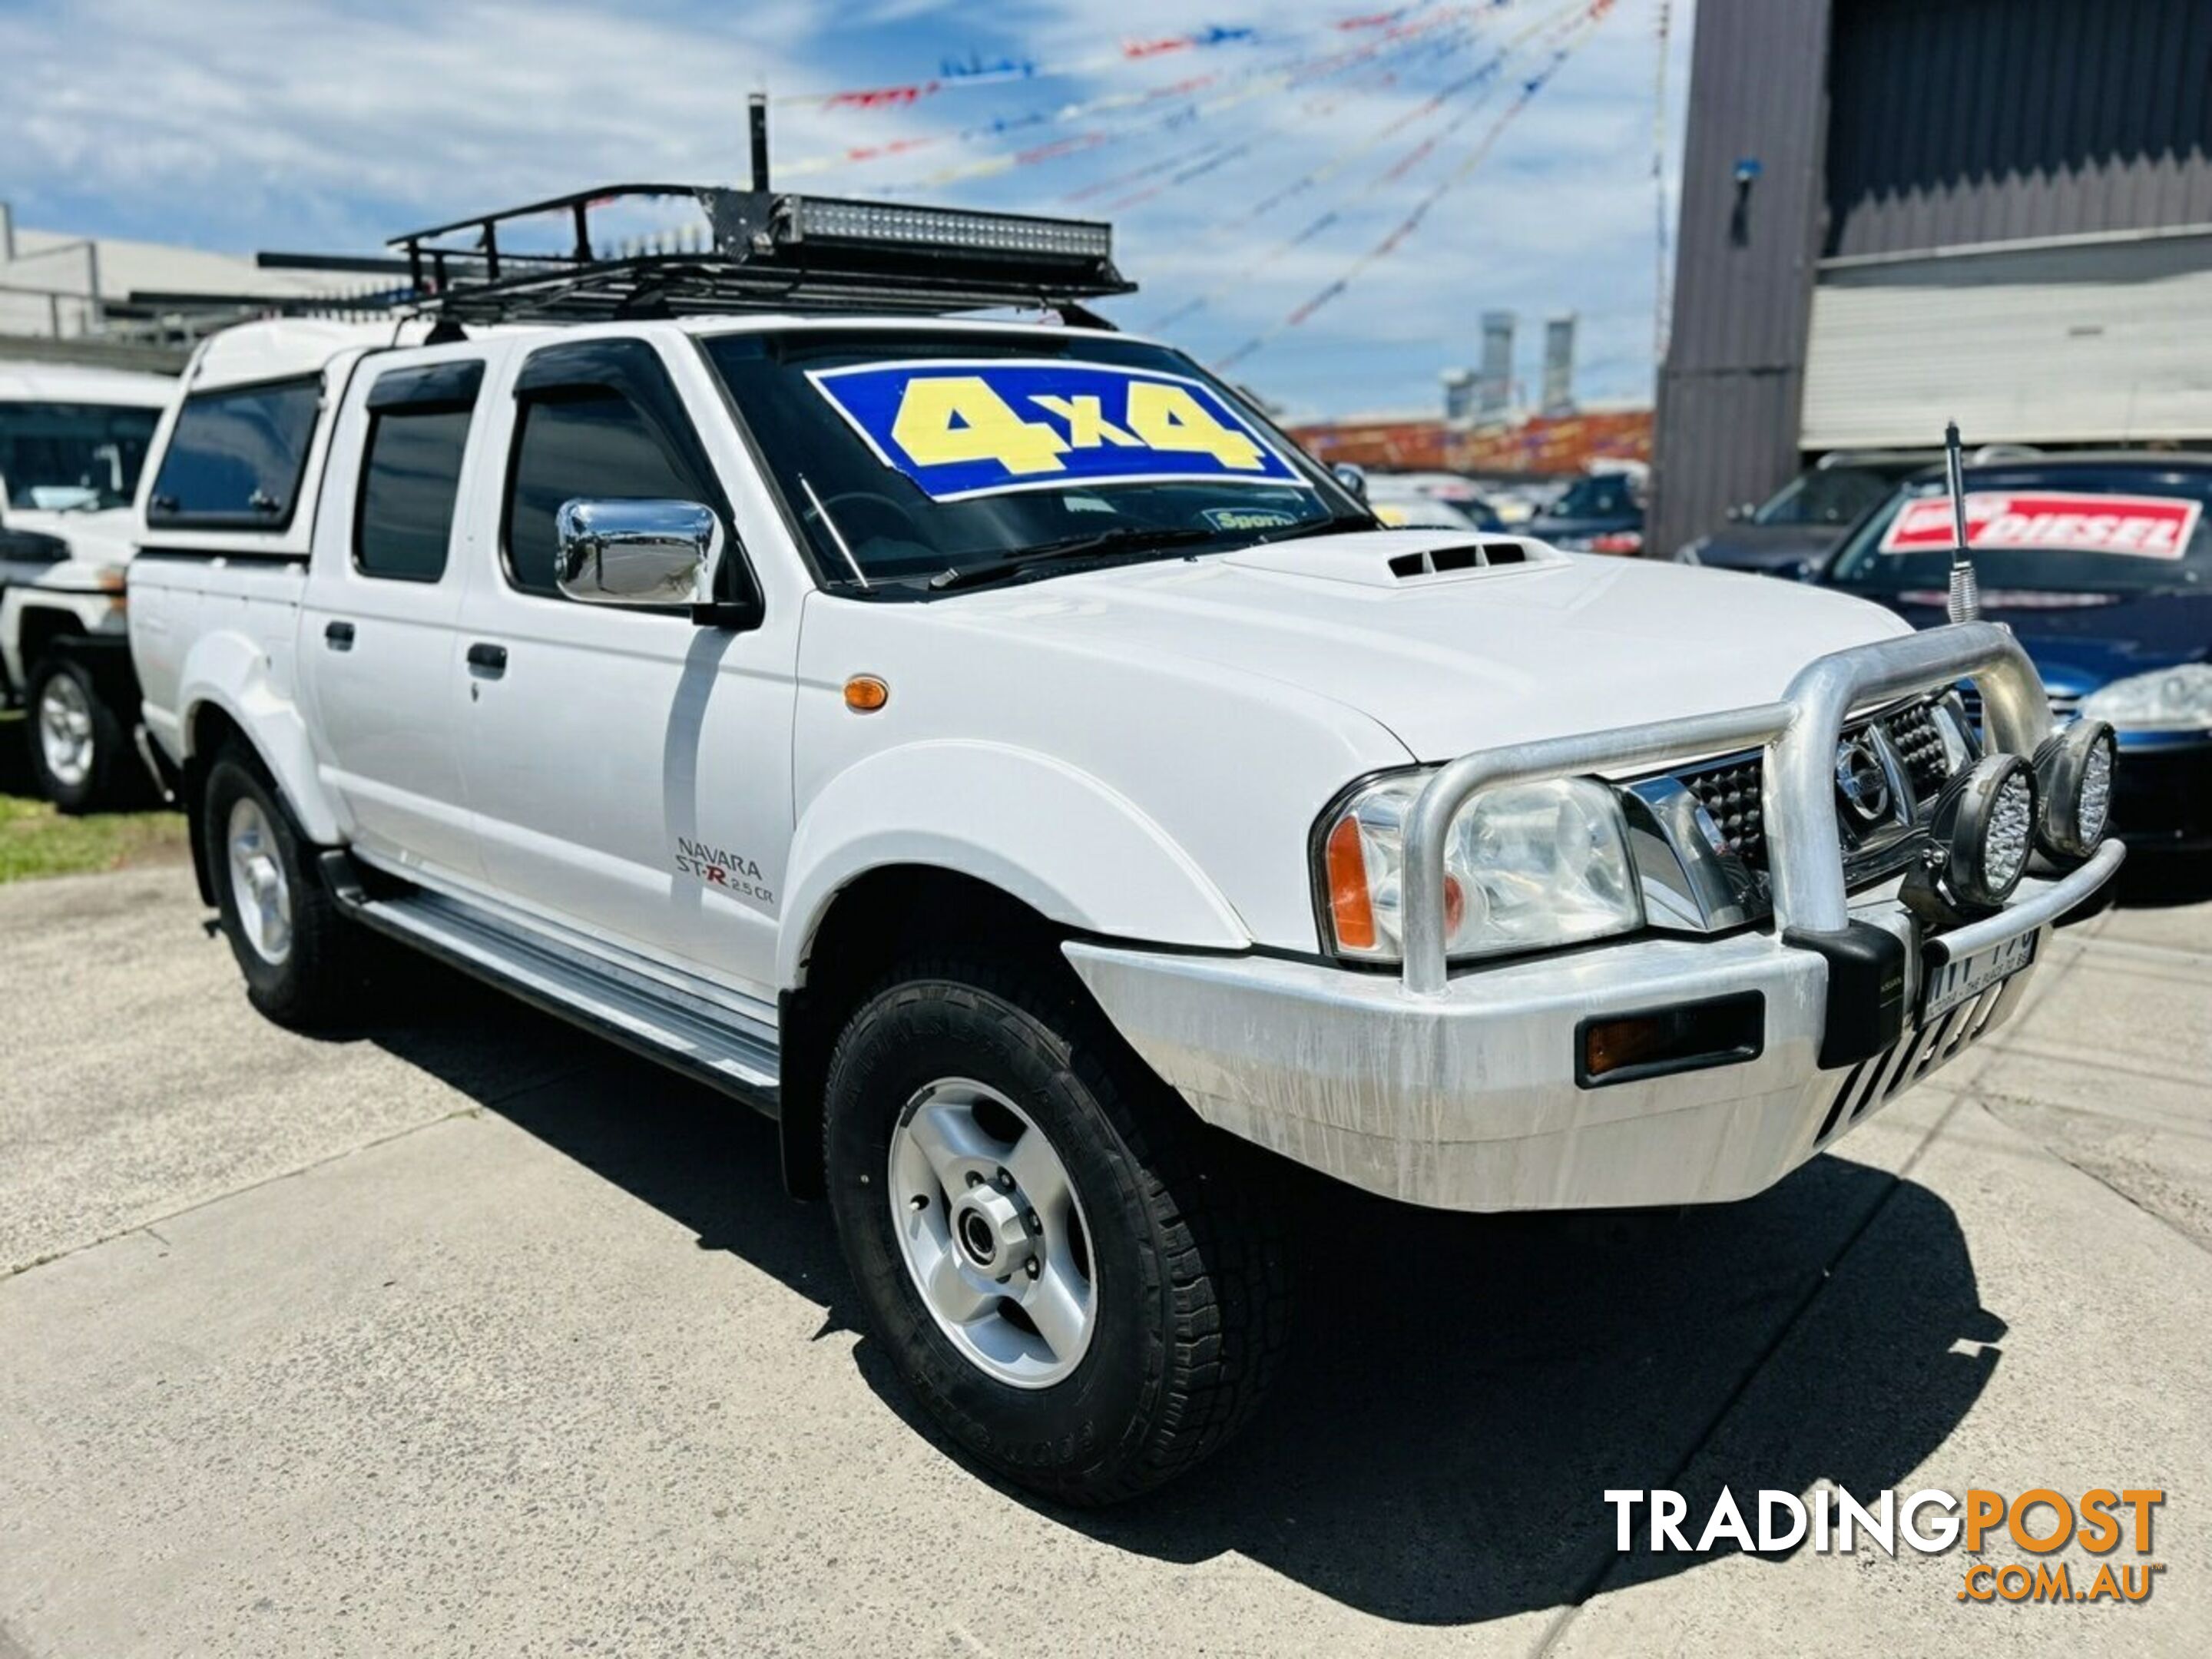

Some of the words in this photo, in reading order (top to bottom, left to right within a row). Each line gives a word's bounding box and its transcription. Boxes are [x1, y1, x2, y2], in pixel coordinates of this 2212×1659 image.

[1977, 512, 2181, 551] DIESEL
[678, 836, 763, 882] NAVARA
[731, 878, 753, 896] 2.5
[754, 886, 774, 905] CR
